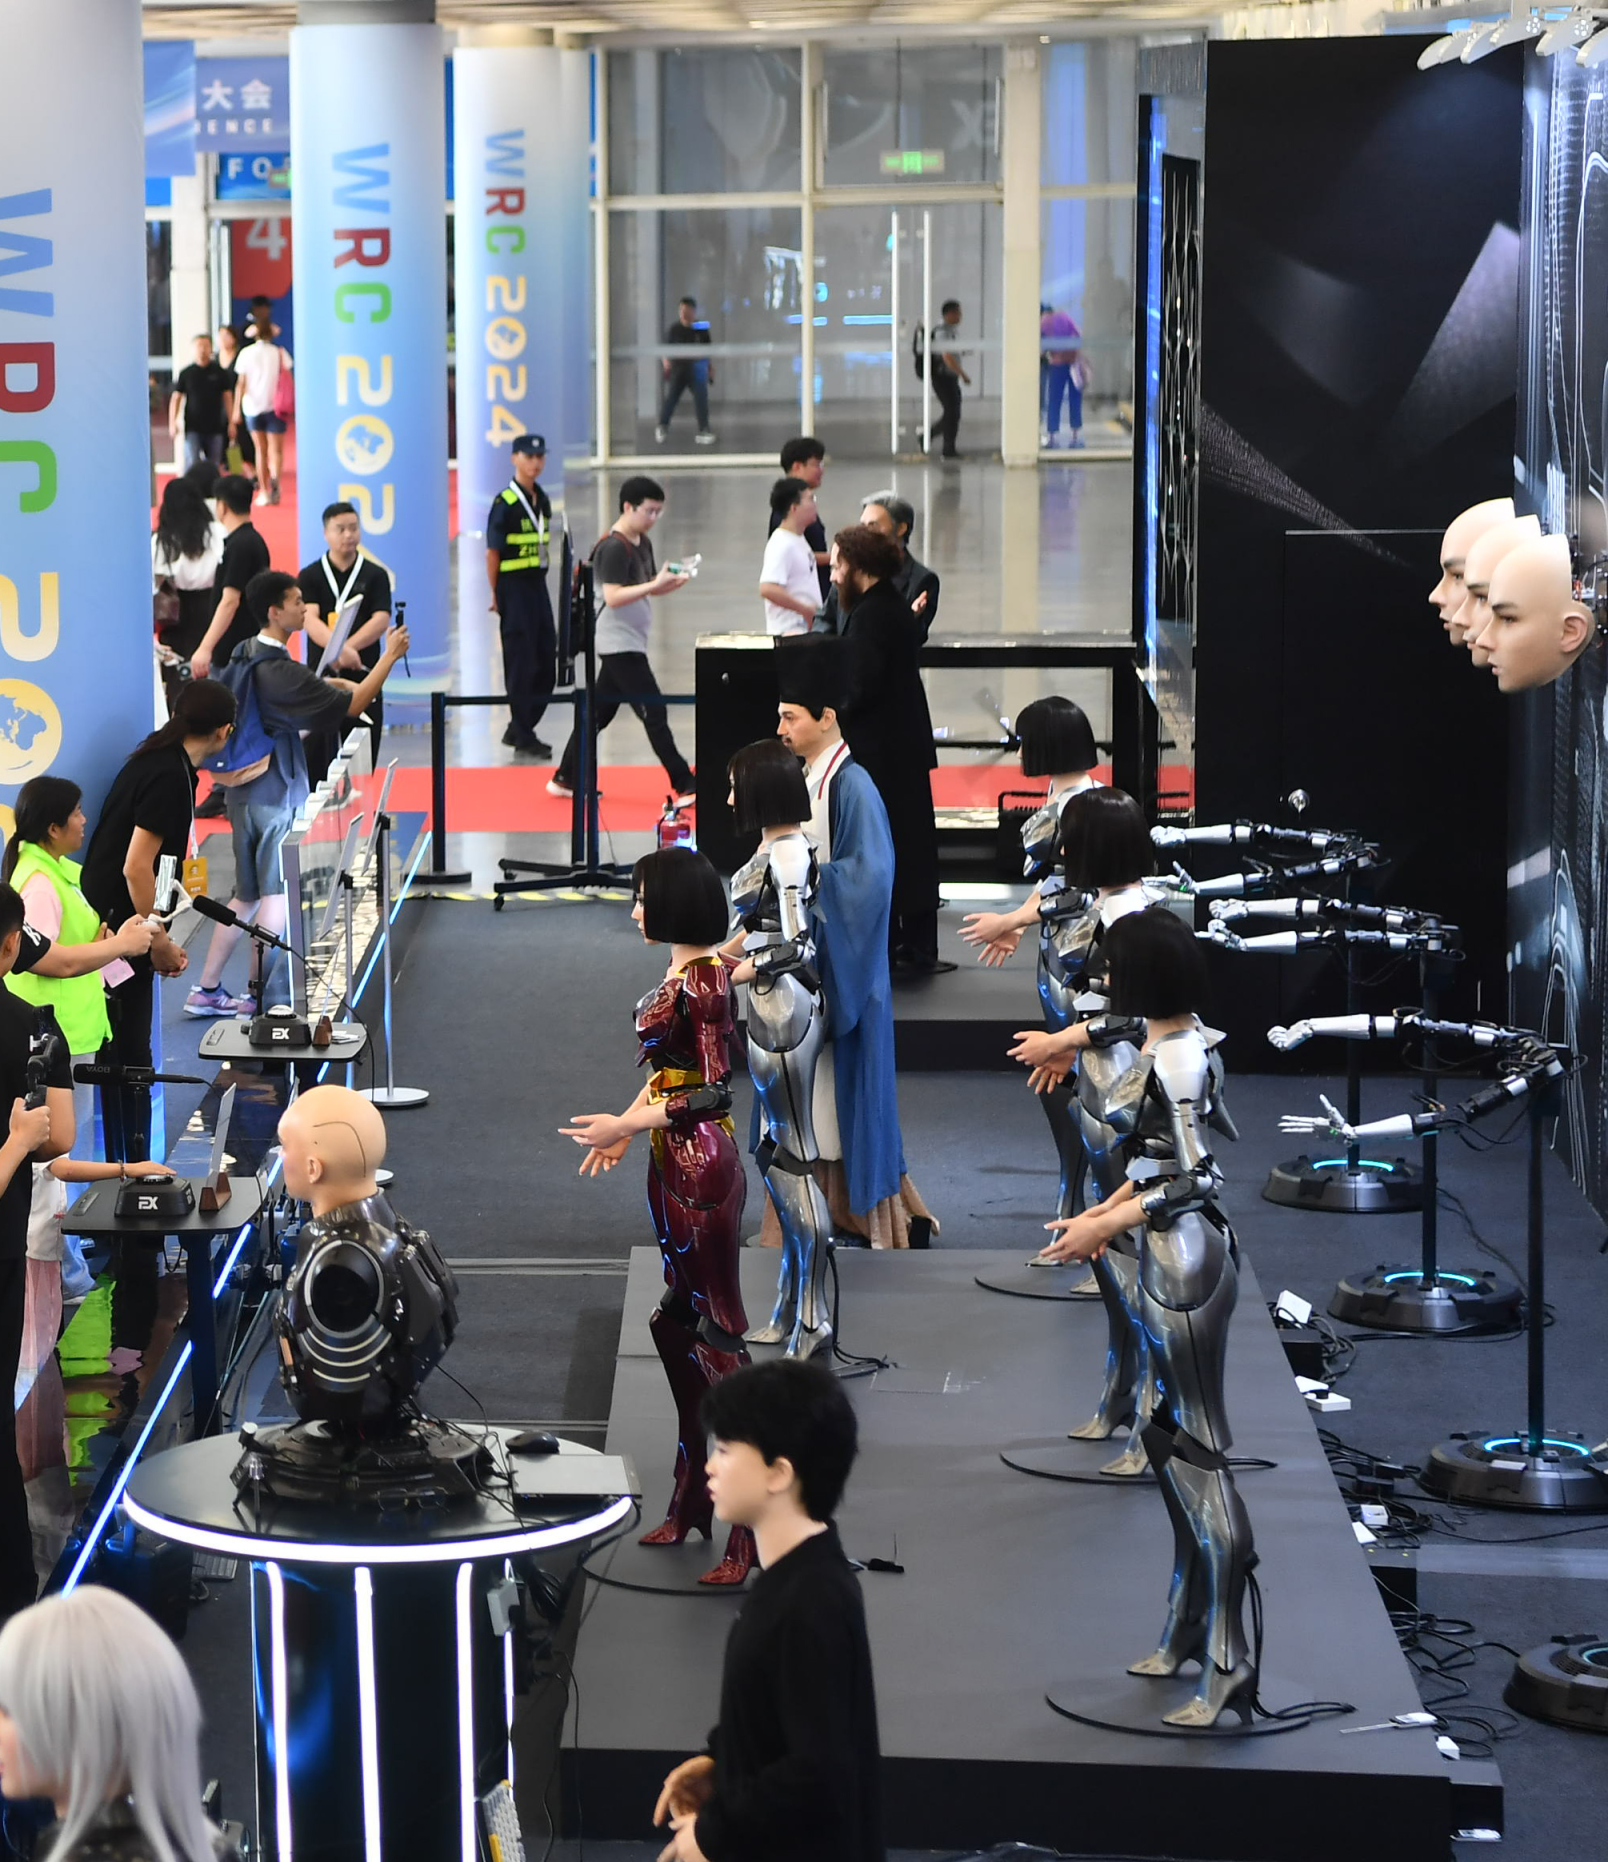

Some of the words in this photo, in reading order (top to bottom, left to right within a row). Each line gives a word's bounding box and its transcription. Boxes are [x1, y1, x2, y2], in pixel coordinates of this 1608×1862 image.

[201, 78, 273, 111] 大会
[228, 156, 290, 180] FO
[484, 128, 527, 256] WRC
[331, 142, 392, 324] WRC
[485, 274, 528, 448] 2024
[271, 1027, 290, 1040] EX
[85, 1065, 111, 1074] BOYA
[138, 1195, 159, 1210] EX
